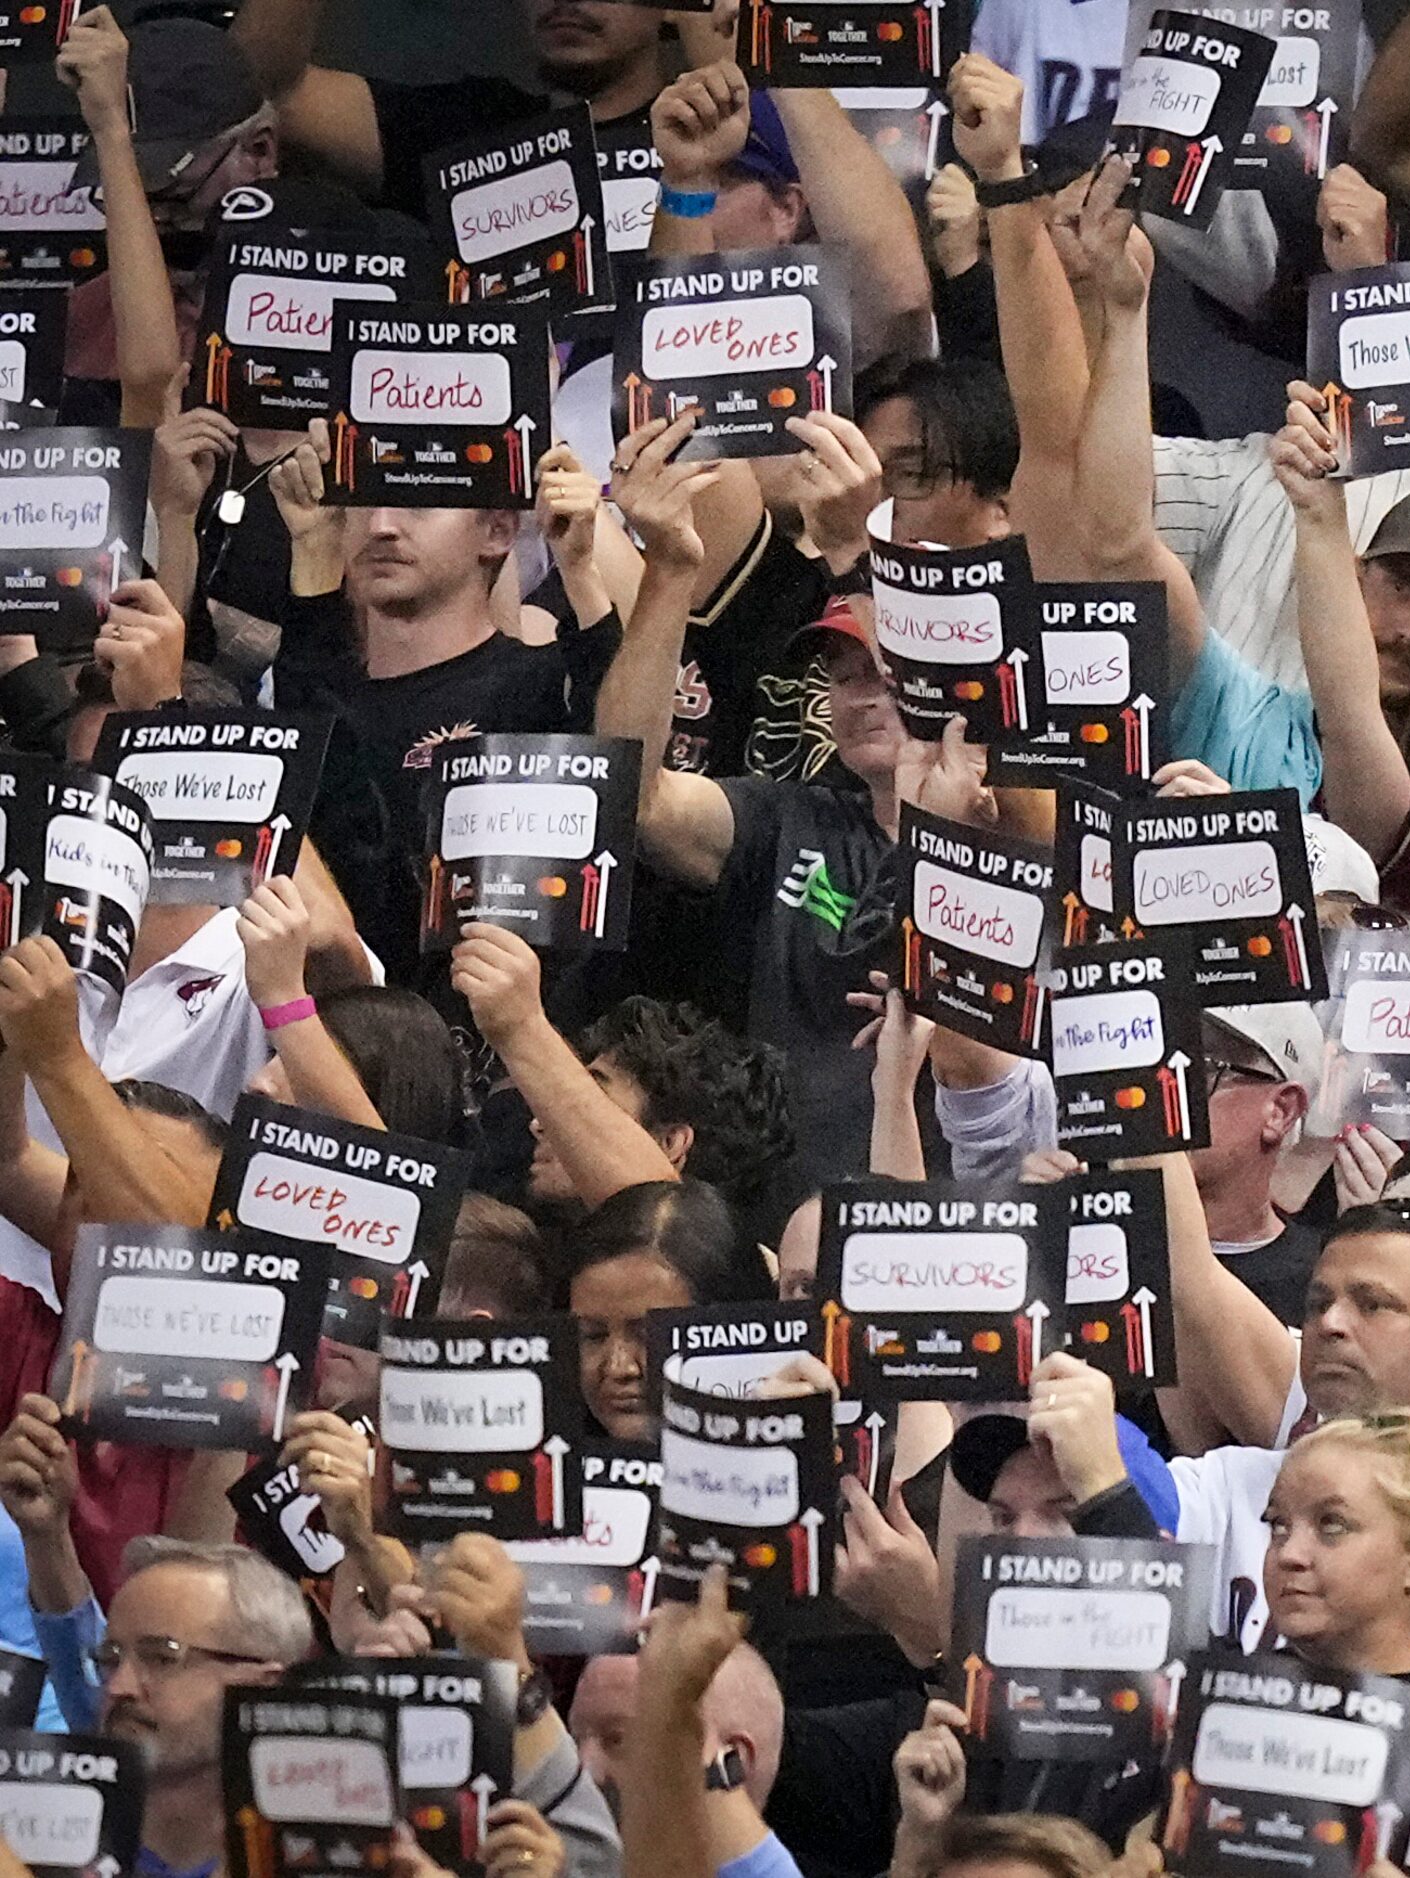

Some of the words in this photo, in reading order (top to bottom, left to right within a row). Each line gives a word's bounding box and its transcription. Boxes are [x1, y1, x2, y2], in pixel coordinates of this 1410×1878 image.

[1150, 89, 1207, 112] FIGHT
[440, 170, 446, 189] I
[449, 151, 506, 186] STAND
[510, 141, 533, 165] UP
[537, 128, 572, 157] FOR
[461, 188, 572, 242] SURVIVORS
[229, 244, 236, 263] I
[240, 245, 308, 270] STAND
[315, 252, 347, 273] UP
[355, 254, 405, 277] FOR
[637, 282, 642, 302] I
[648, 273, 724, 300] STAND
[731, 269, 763, 292] UP
[771, 264, 819, 289] FOR
[1331, 291, 1337, 312] I
[349, 320, 354, 340] I
[359, 320, 421, 343] STAND
[428, 323, 460, 344] UP
[468, 323, 517, 345] FOR
[654, 316, 743, 352] LOVED
[728, 331, 802, 361] ONES
[1349, 340, 1399, 371] Those
[369, 368, 484, 410] Patients
[34, 447, 65, 468] UP
[72, 447, 120, 468] FOR
[415, 451, 456, 463] TOGETHER
[11, 503, 46, 527] the
[51, 502, 102, 530] Fight
[1043, 602, 1076, 624] UP
[1084, 601, 1136, 624] FOR
[1048, 656, 1123, 692] ONES
[120, 728, 130, 747] I
[133, 725, 206, 747] STAND
[212, 725, 244, 745] UP
[249, 726, 299, 749] FOR
[442, 761, 447, 781] I
[451, 753, 512, 779] STAND
[518, 756, 552, 777] UP
[557, 755, 608, 779] FOR
[175, 774, 222, 799] We've
[225, 775, 268, 801] Lost
[1127, 821, 1132, 843] I
[1137, 816, 1197, 842] STAND
[1202, 813, 1230, 836] UP
[1236, 810, 1279, 834] FOR
[48, 835, 93, 866] Kids
[1140, 869, 1211, 908] LOVED
[1212, 870, 1276, 908] ONES
[928, 884, 1014, 947] Patients
[1065, 964, 1102, 989] UP
[1109, 957, 1165, 985] FOR
[1341, 950, 1350, 970] I
[1066, 1023, 1095, 1049] the
[1098, 1016, 1155, 1050] Fight
[250, 1118, 259, 1139] I
[262, 1122, 339, 1160] STAND
[345, 1143, 381, 1170] UP
[385, 1155, 437, 1187] FOR
[254, 1176, 347, 1212] LOVED
[839, 1203, 847, 1225] I
[852, 1202, 932, 1226] STAND
[939, 1202, 976, 1226] UP
[982, 1201, 1037, 1227] FOR
[323, 1213, 400, 1248] ONES
[849, 1261, 1018, 1290] SURVIVORS
[672, 1327, 679, 1350] I
[687, 1322, 767, 1349] STAND
[774, 1320, 807, 1343] UP
